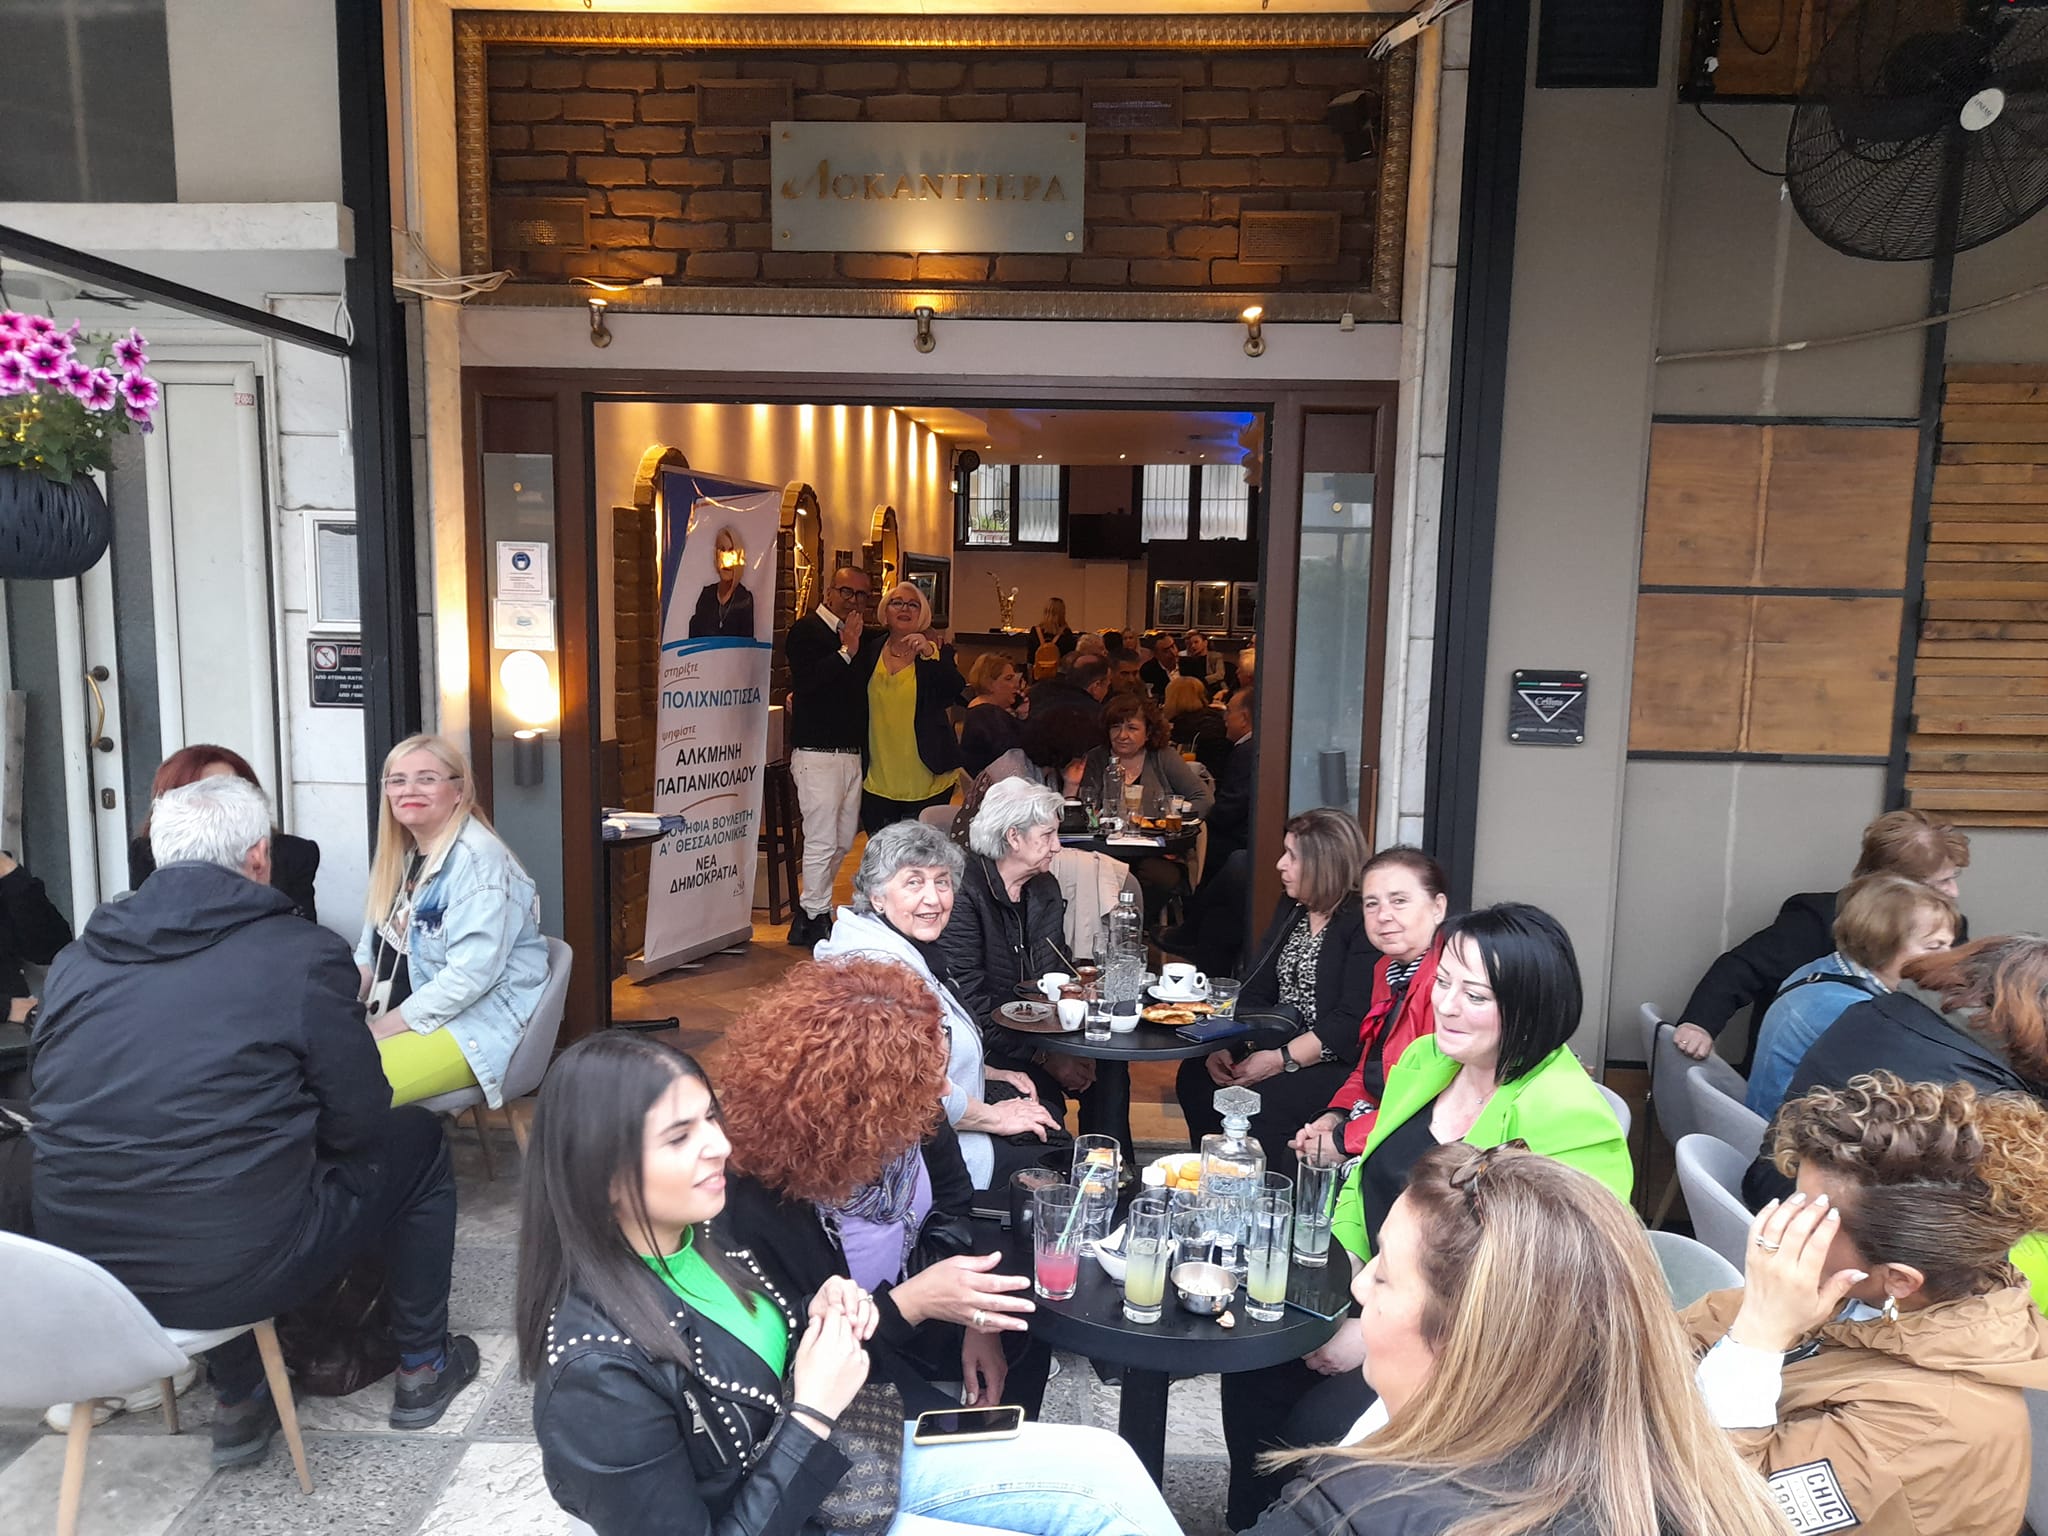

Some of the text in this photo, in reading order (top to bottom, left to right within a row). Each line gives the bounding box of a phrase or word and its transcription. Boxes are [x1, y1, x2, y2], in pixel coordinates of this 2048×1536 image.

[662, 688, 761, 709] ΠΟΛΙΧΝΙΩΤΙΣΣΑ
[675, 743, 742, 767] ΑΛΚΜΗΝΗ
[656, 765, 757, 797] ΠΑΠΑΝΙΚΟΛΑΟΥ
[712, 809, 754, 830] ΒΟΥΛΕΥΤΗ
[675, 824, 748, 853] ΘΕΣΣΑΛΟΝΙΚΗΣ
[696, 854, 717, 872] ΝΕΑ
[669, 864, 738, 894] ΔΗΜΟΚΡΑΤΙΑ
[1806, 1472, 1844, 1520] CHIC
